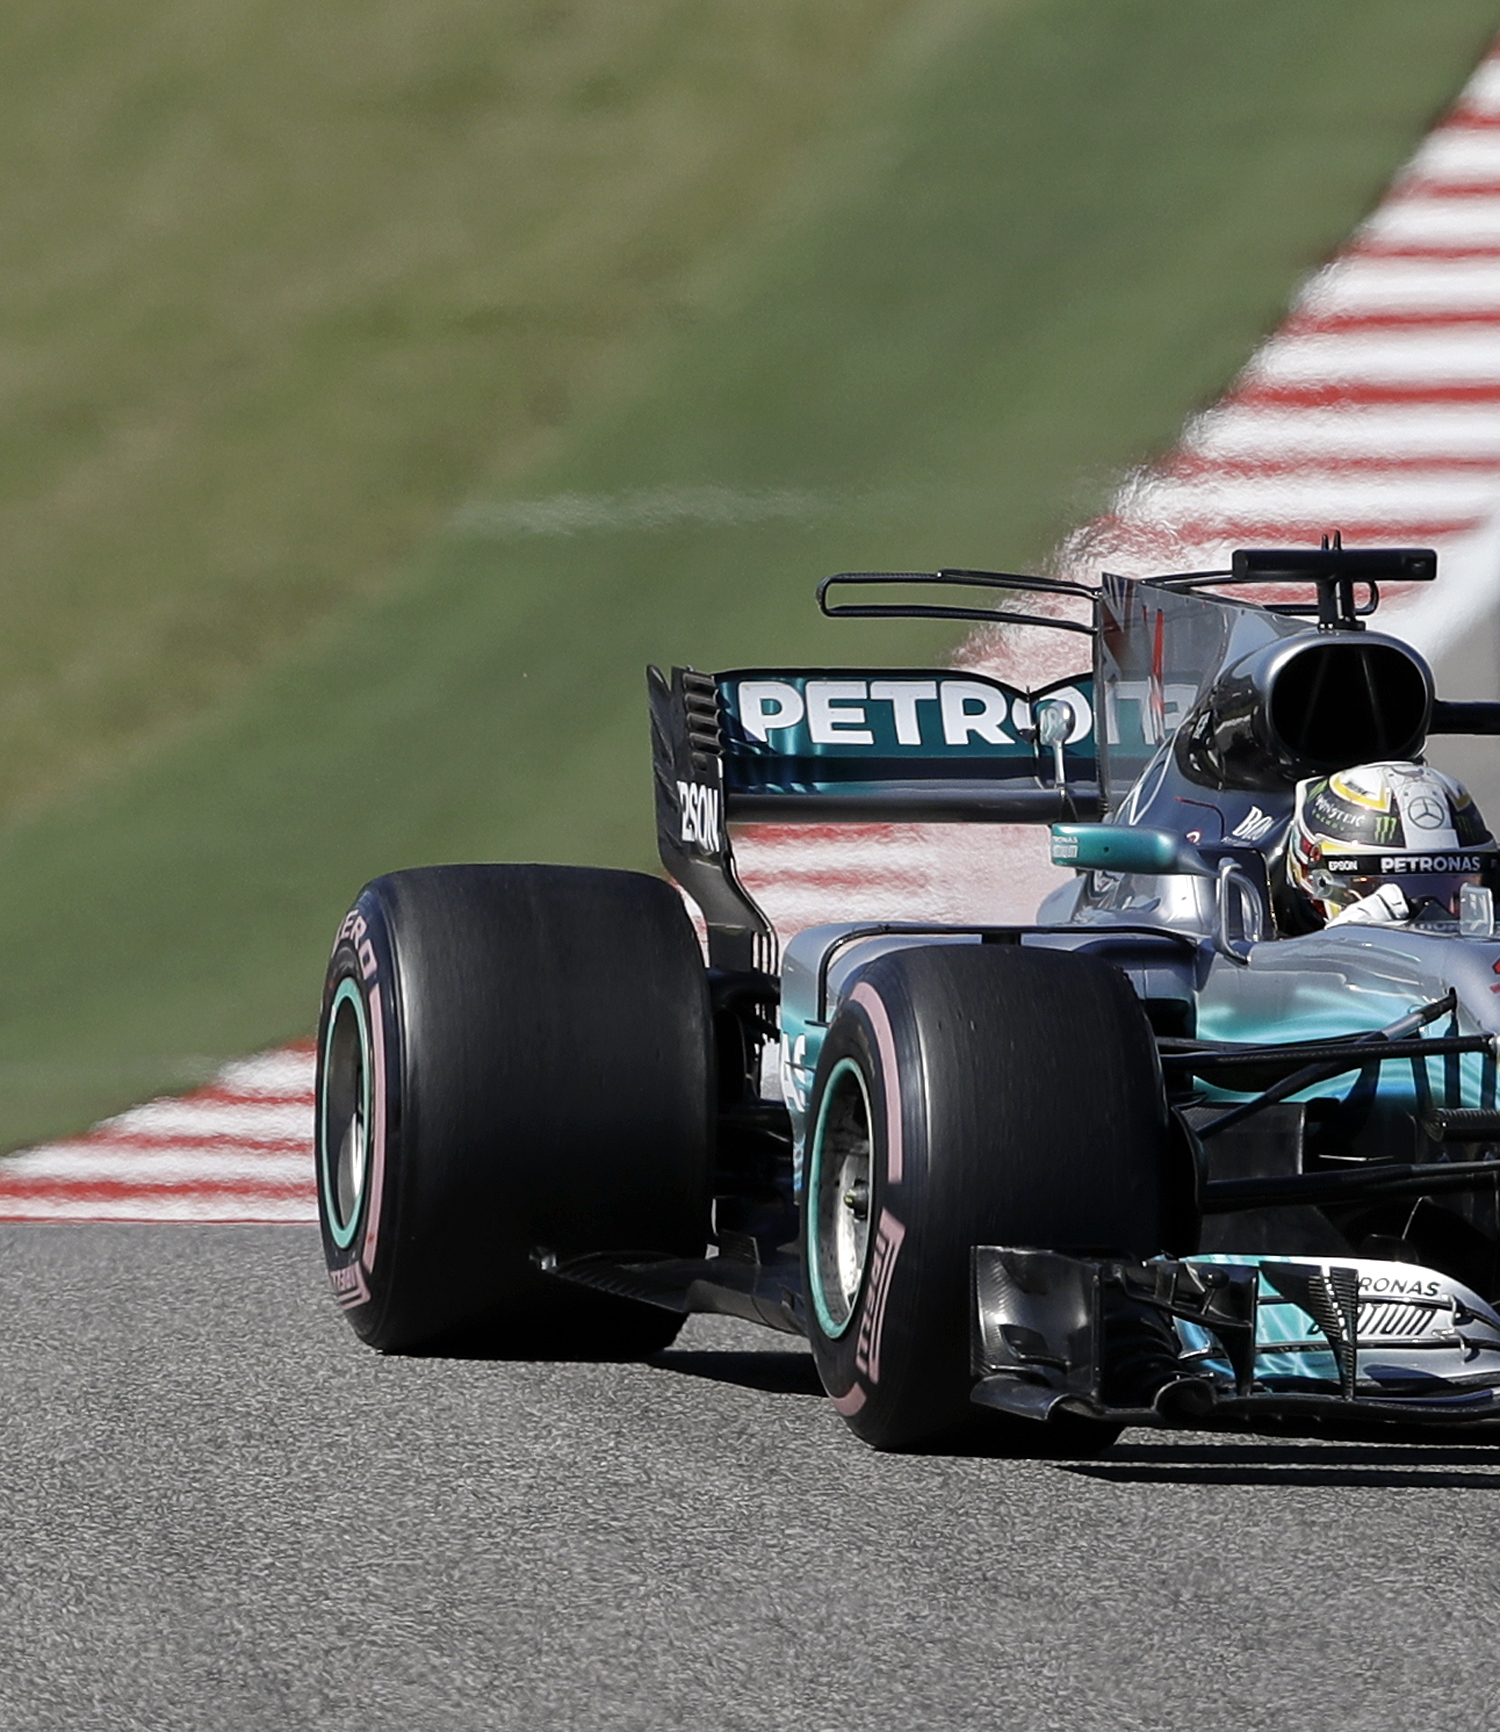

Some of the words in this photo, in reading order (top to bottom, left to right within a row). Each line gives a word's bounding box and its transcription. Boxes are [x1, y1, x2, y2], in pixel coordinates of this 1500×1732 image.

[1328, 860, 1358, 872] EPSON
[1380, 856, 1481, 873] PETRONAS
[1358, 1276, 1441, 1297] RONAS
